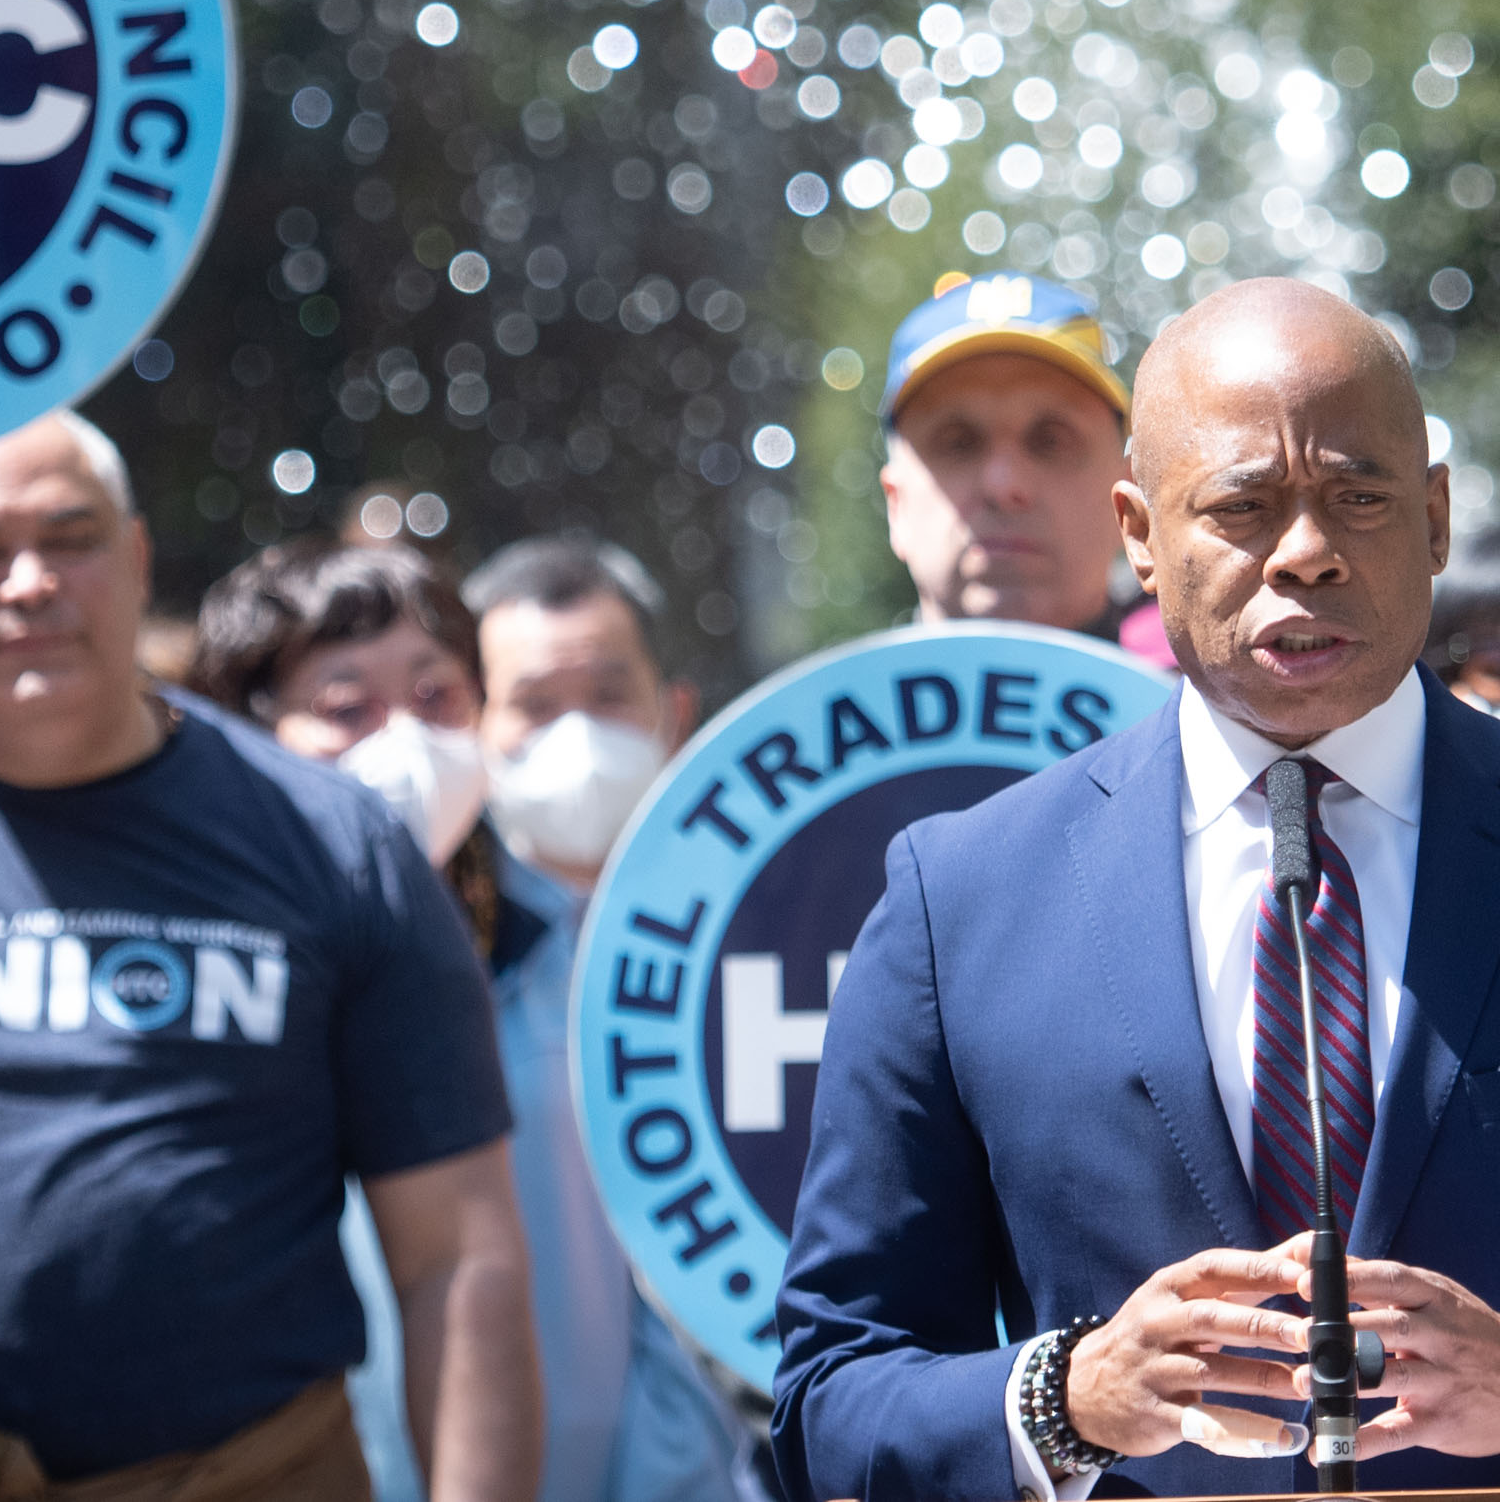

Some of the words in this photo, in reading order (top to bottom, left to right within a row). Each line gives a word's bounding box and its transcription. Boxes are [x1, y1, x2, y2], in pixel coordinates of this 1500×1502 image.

[606, 900, 737, 1266] HOTEL
[681, 671, 1119, 851] TRADES
[1332, 1441, 1350, 1455] 30
